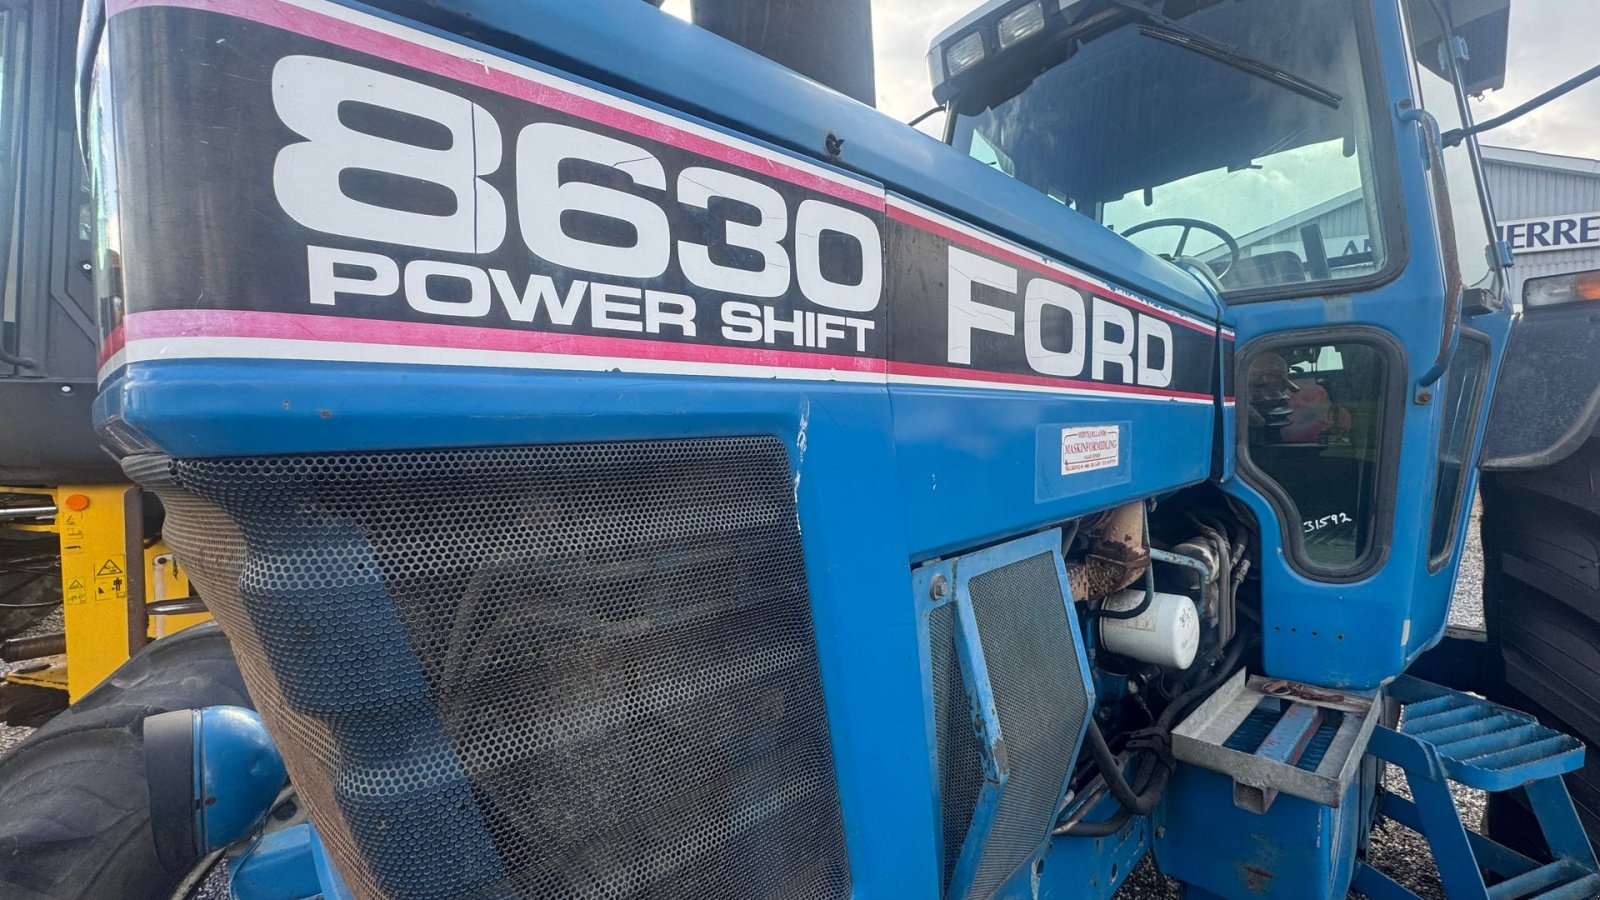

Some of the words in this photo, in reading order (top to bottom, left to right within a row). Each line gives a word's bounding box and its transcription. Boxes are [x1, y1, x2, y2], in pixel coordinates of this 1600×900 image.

[272, 54, 882, 313] 8630
[307, 244, 697, 338] POWER
[721, 300, 876, 353] SHIFT
[947, 245, 1173, 388] FORD
[1303, 512, 1352, 533] 31592
